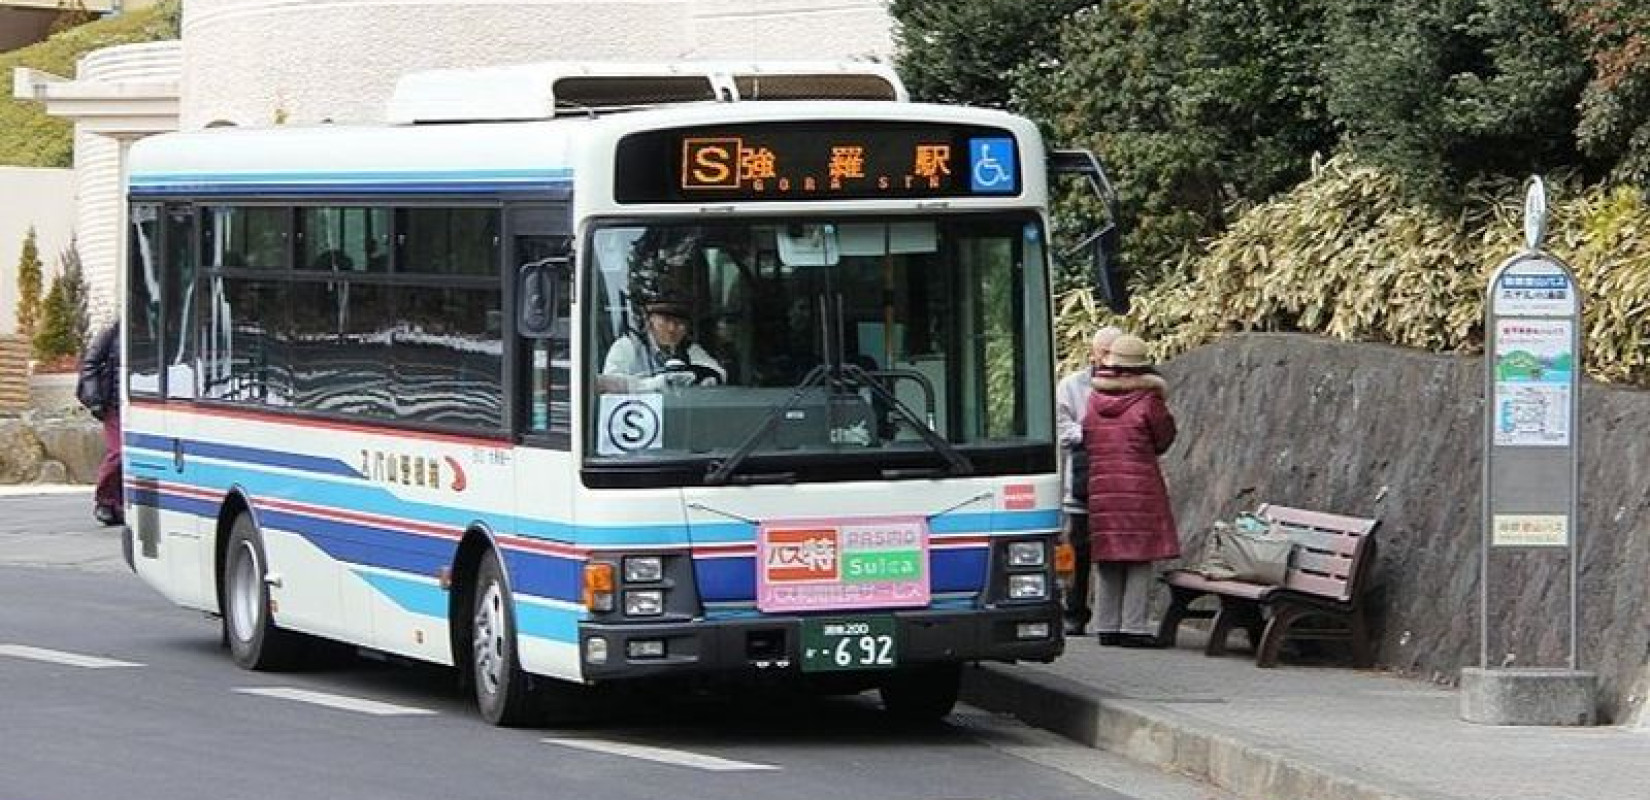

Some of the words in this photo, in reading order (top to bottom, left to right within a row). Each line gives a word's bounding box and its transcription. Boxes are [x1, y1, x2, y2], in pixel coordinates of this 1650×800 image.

[692, 145, 733, 183] S
[753, 175, 841, 190] GORA
[878, 174, 940, 190] STN
[767, 537, 836, 572] バス特
[850, 557, 914, 576] Suica
[823, 623, 870, 637] 200
